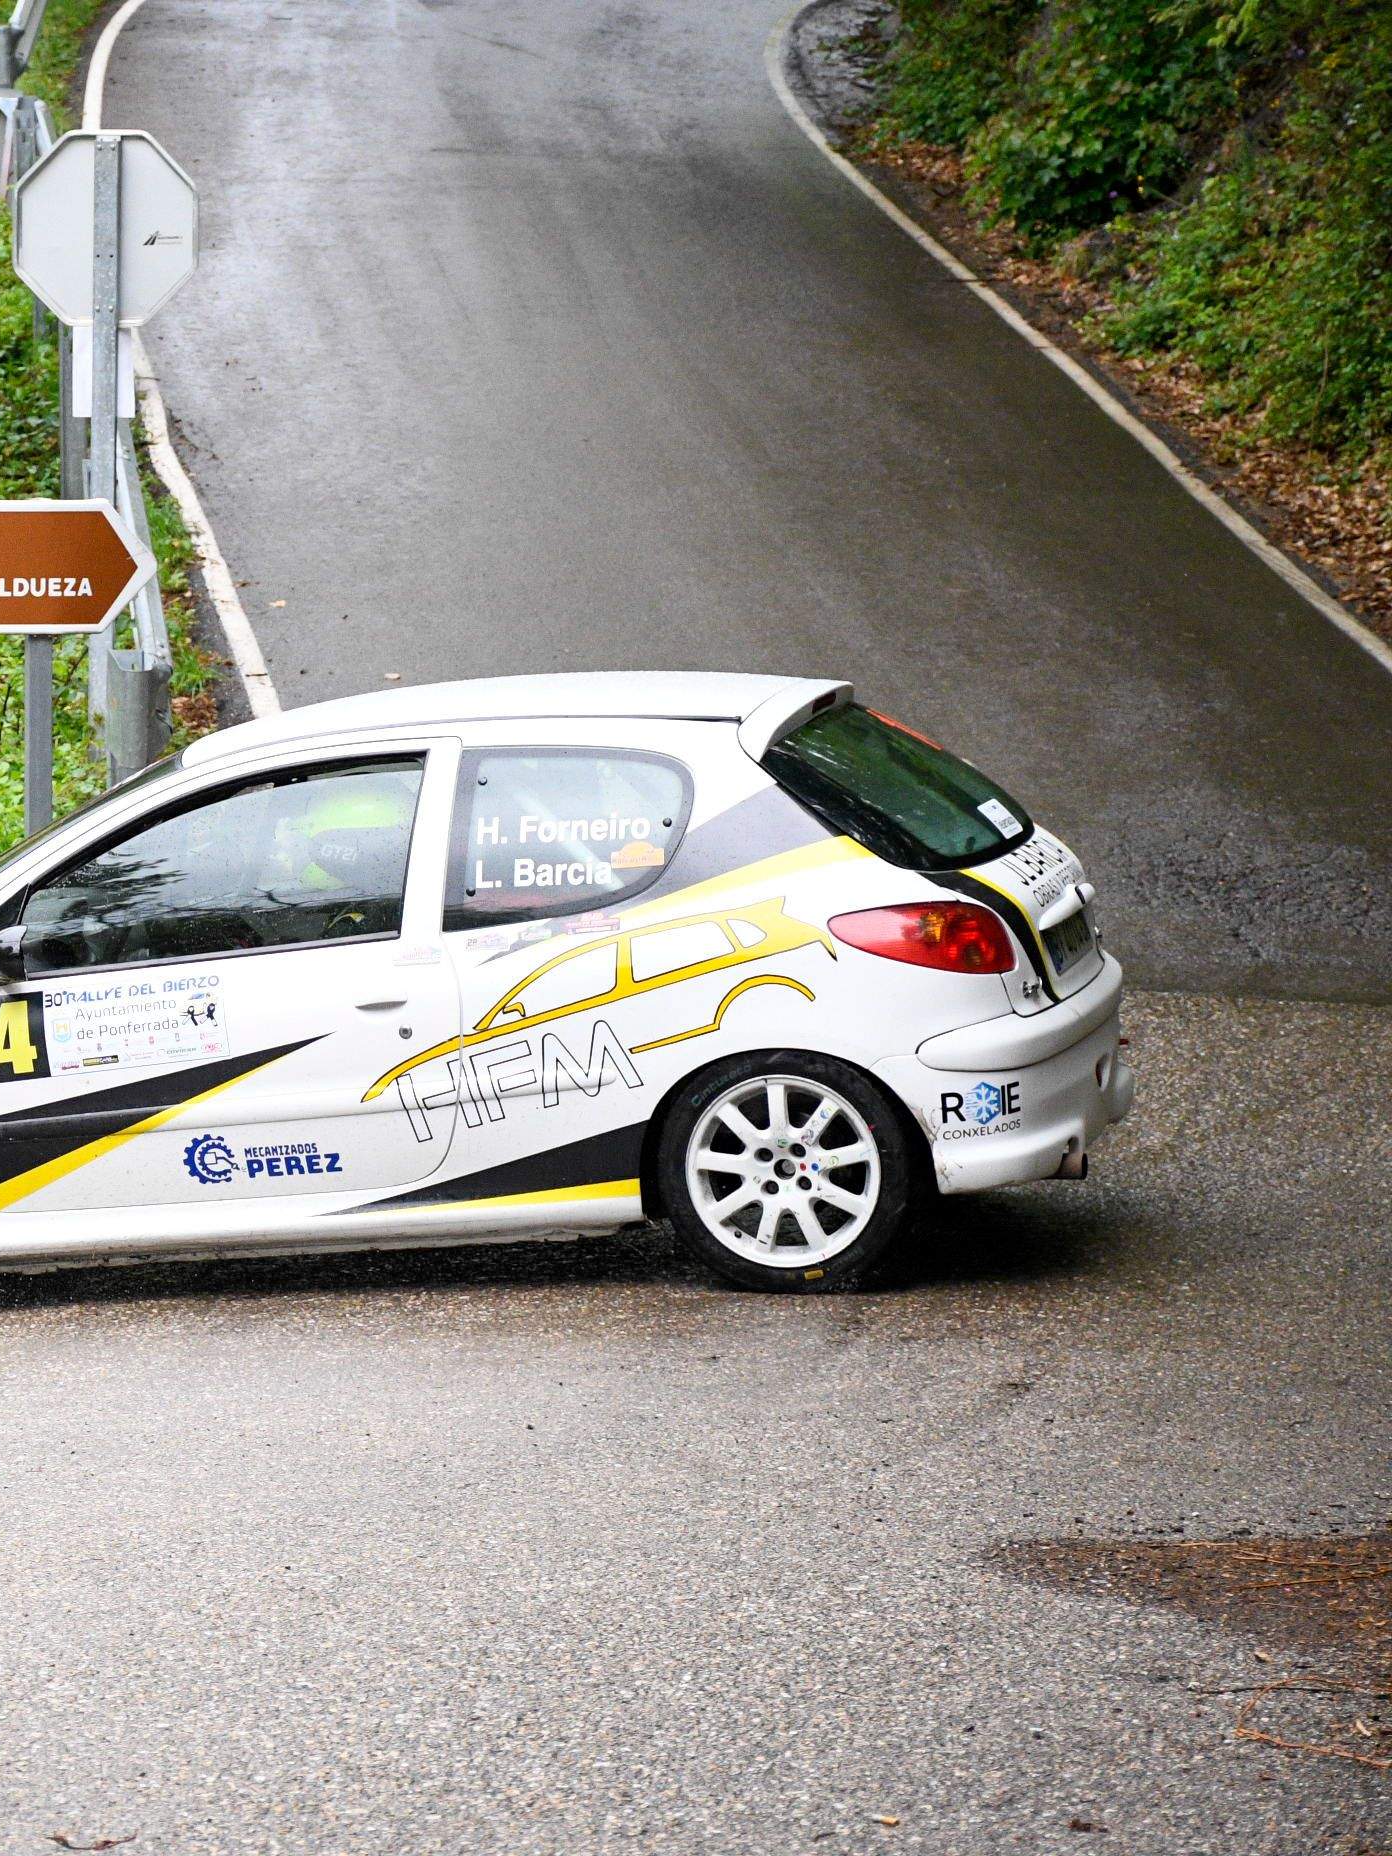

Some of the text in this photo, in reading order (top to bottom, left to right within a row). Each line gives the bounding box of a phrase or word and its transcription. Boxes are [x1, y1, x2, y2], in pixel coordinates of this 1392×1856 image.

[476, 812, 651, 845] H. Forneiro
[475, 860, 503, 889] L.
[513, 857, 612, 888] Barcia
[66, 986, 123, 1004] RALLYE
[128, 983, 156, 997] DEL
[163, 975, 220, 993] BIERZO
[75, 999, 177, 1021] Ayuntamiento
[76, 1017, 179, 1040] de Ponferrada
[942, 1119, 1021, 1141] CONXELADOS
[243, 1142, 318, 1158] MECANIZADOS
[246, 1152, 343, 1179] PEREZ
